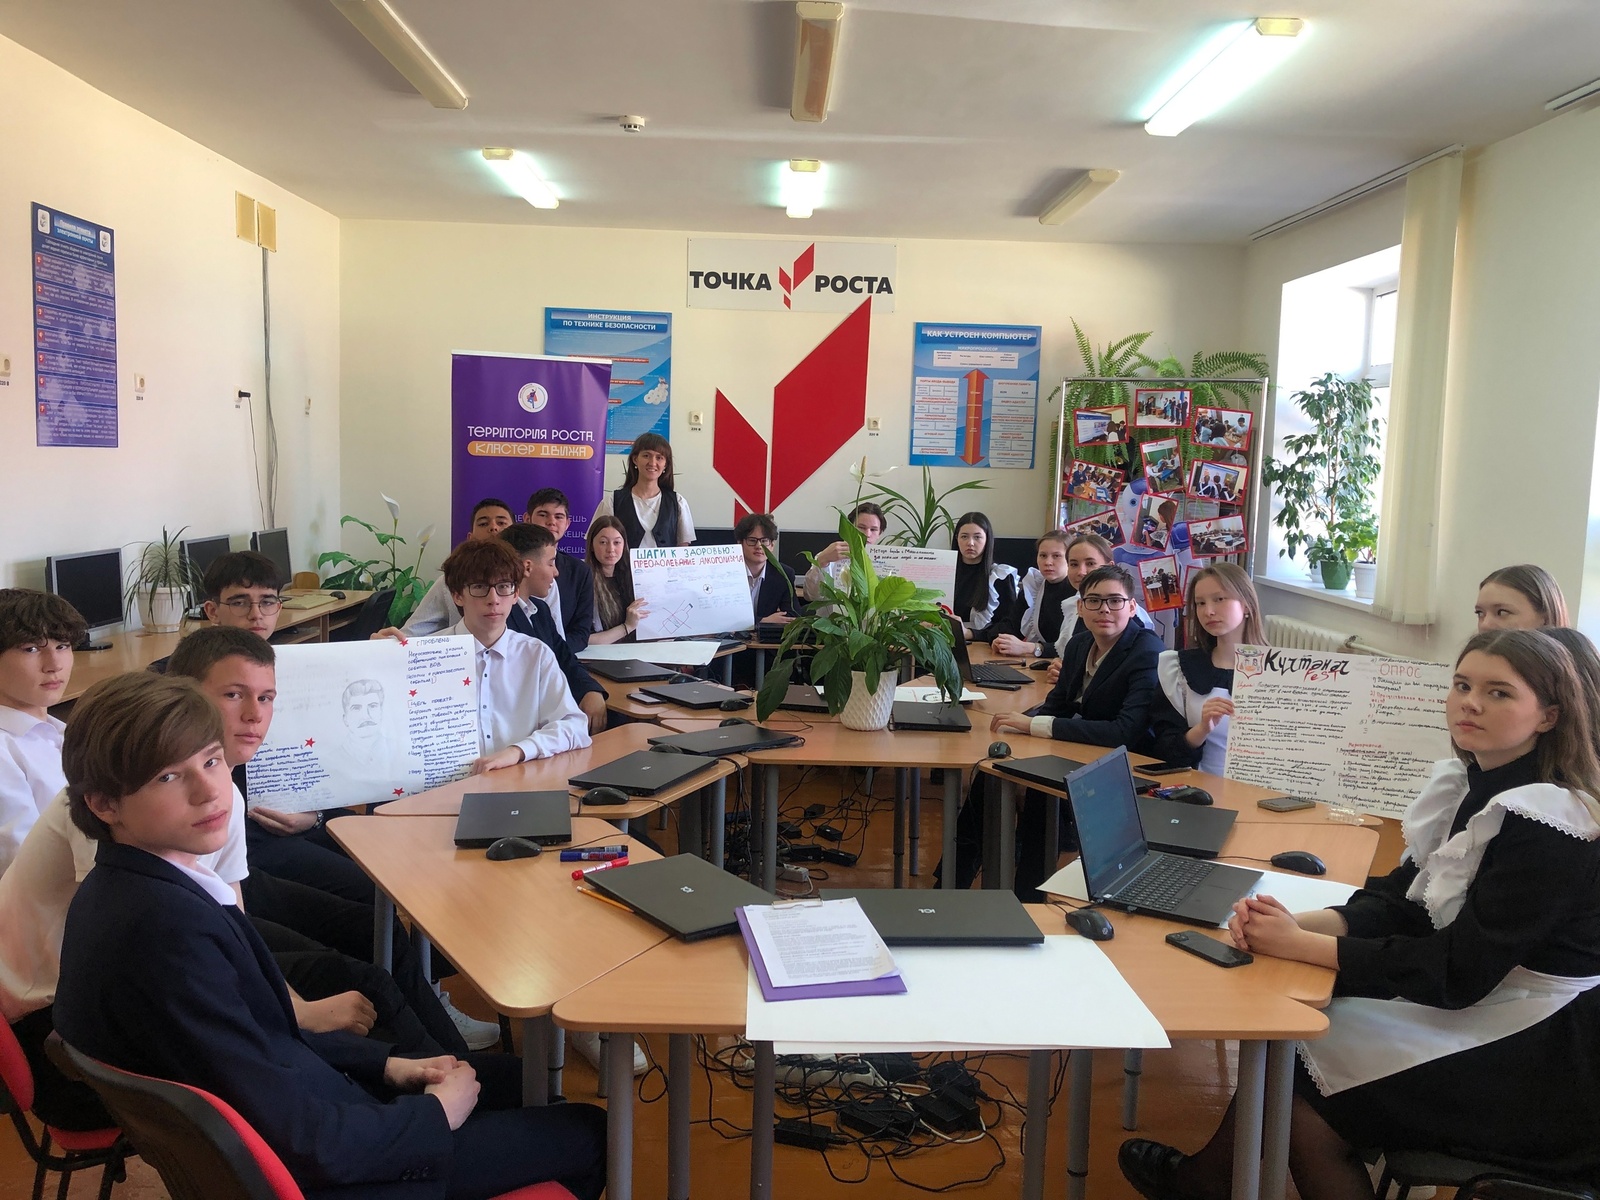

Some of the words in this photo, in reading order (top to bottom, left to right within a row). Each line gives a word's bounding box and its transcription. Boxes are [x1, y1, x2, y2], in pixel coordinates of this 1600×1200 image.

[690, 271, 772, 290] ТОЧКА
[814, 274, 894, 294] РОСТА
[604, 322, 656, 330] БЕЗОПАСНОСТИ
[467, 426, 547, 440] ТЕРРИТОРИЯ
[552, 429, 595, 442] РОСТА.
[476, 443, 536, 454] КЛАСТЕР
[540, 445, 586, 457] ДВИЖА
[637, 549, 666, 559] ШАГИ
[671, 550, 676, 558] К
[684, 546, 734, 558] ЗДОРОВЬЮ:
[634, 558, 696, 568] ПРЕОДОЛЕВАНИЕ
[1380, 663, 1421, 678] ОПРОС
